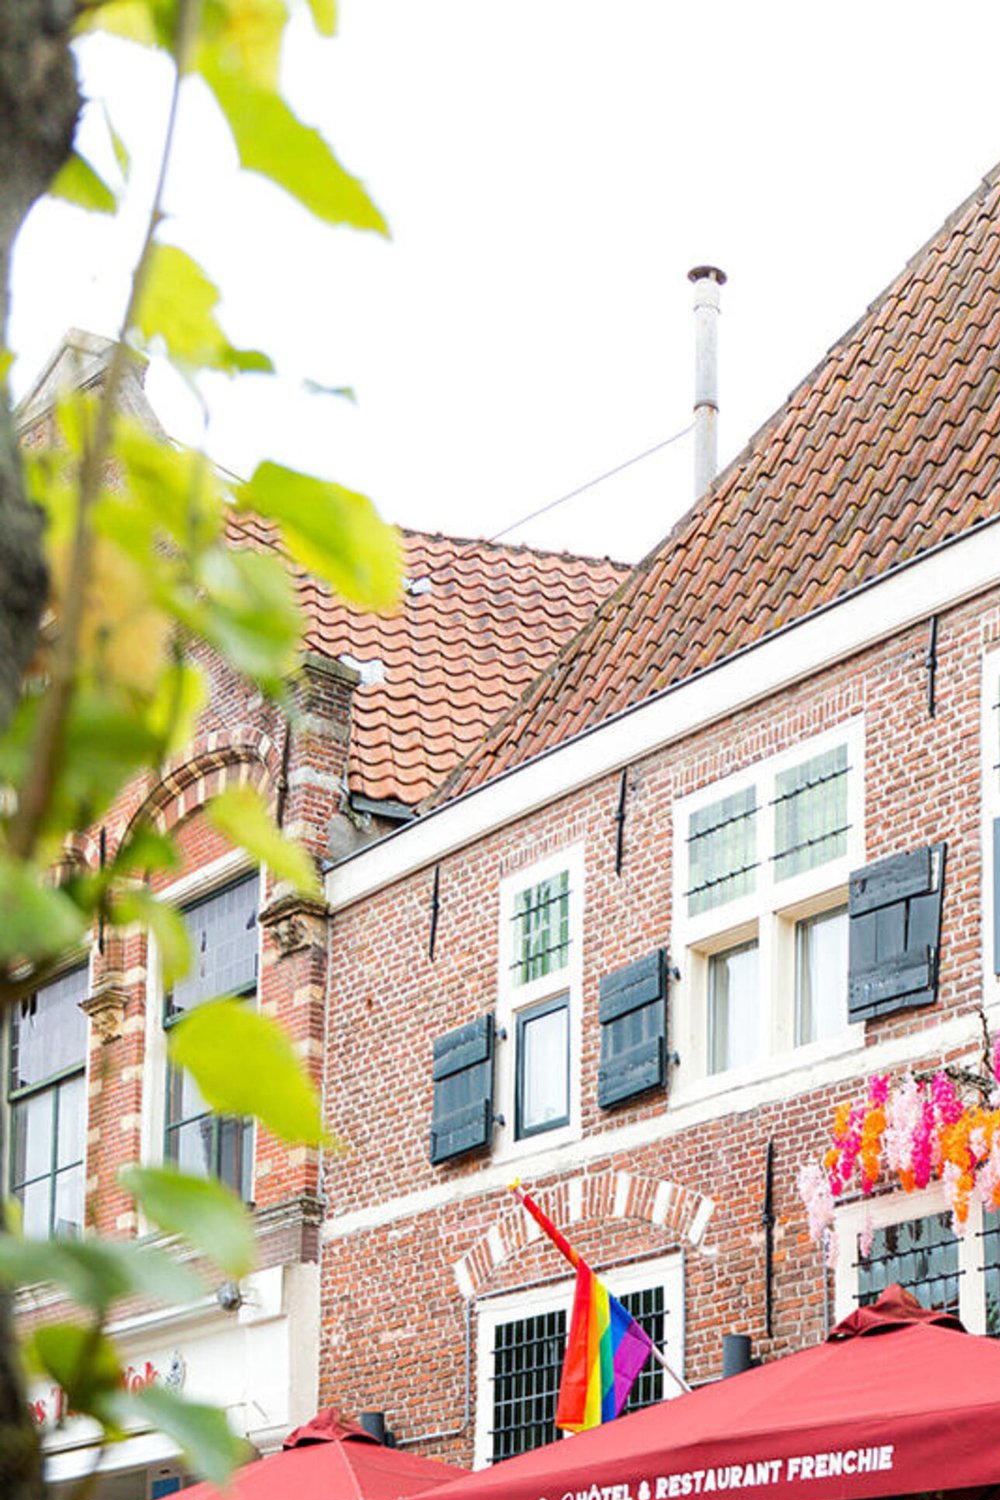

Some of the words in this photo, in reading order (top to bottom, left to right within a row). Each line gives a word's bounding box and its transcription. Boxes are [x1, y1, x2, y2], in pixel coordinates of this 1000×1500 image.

[638, 1481, 651, 1500] &
[655, 1461, 784, 1499] RESTAURANT
[787, 1446, 894, 1481] FRENCHIE
